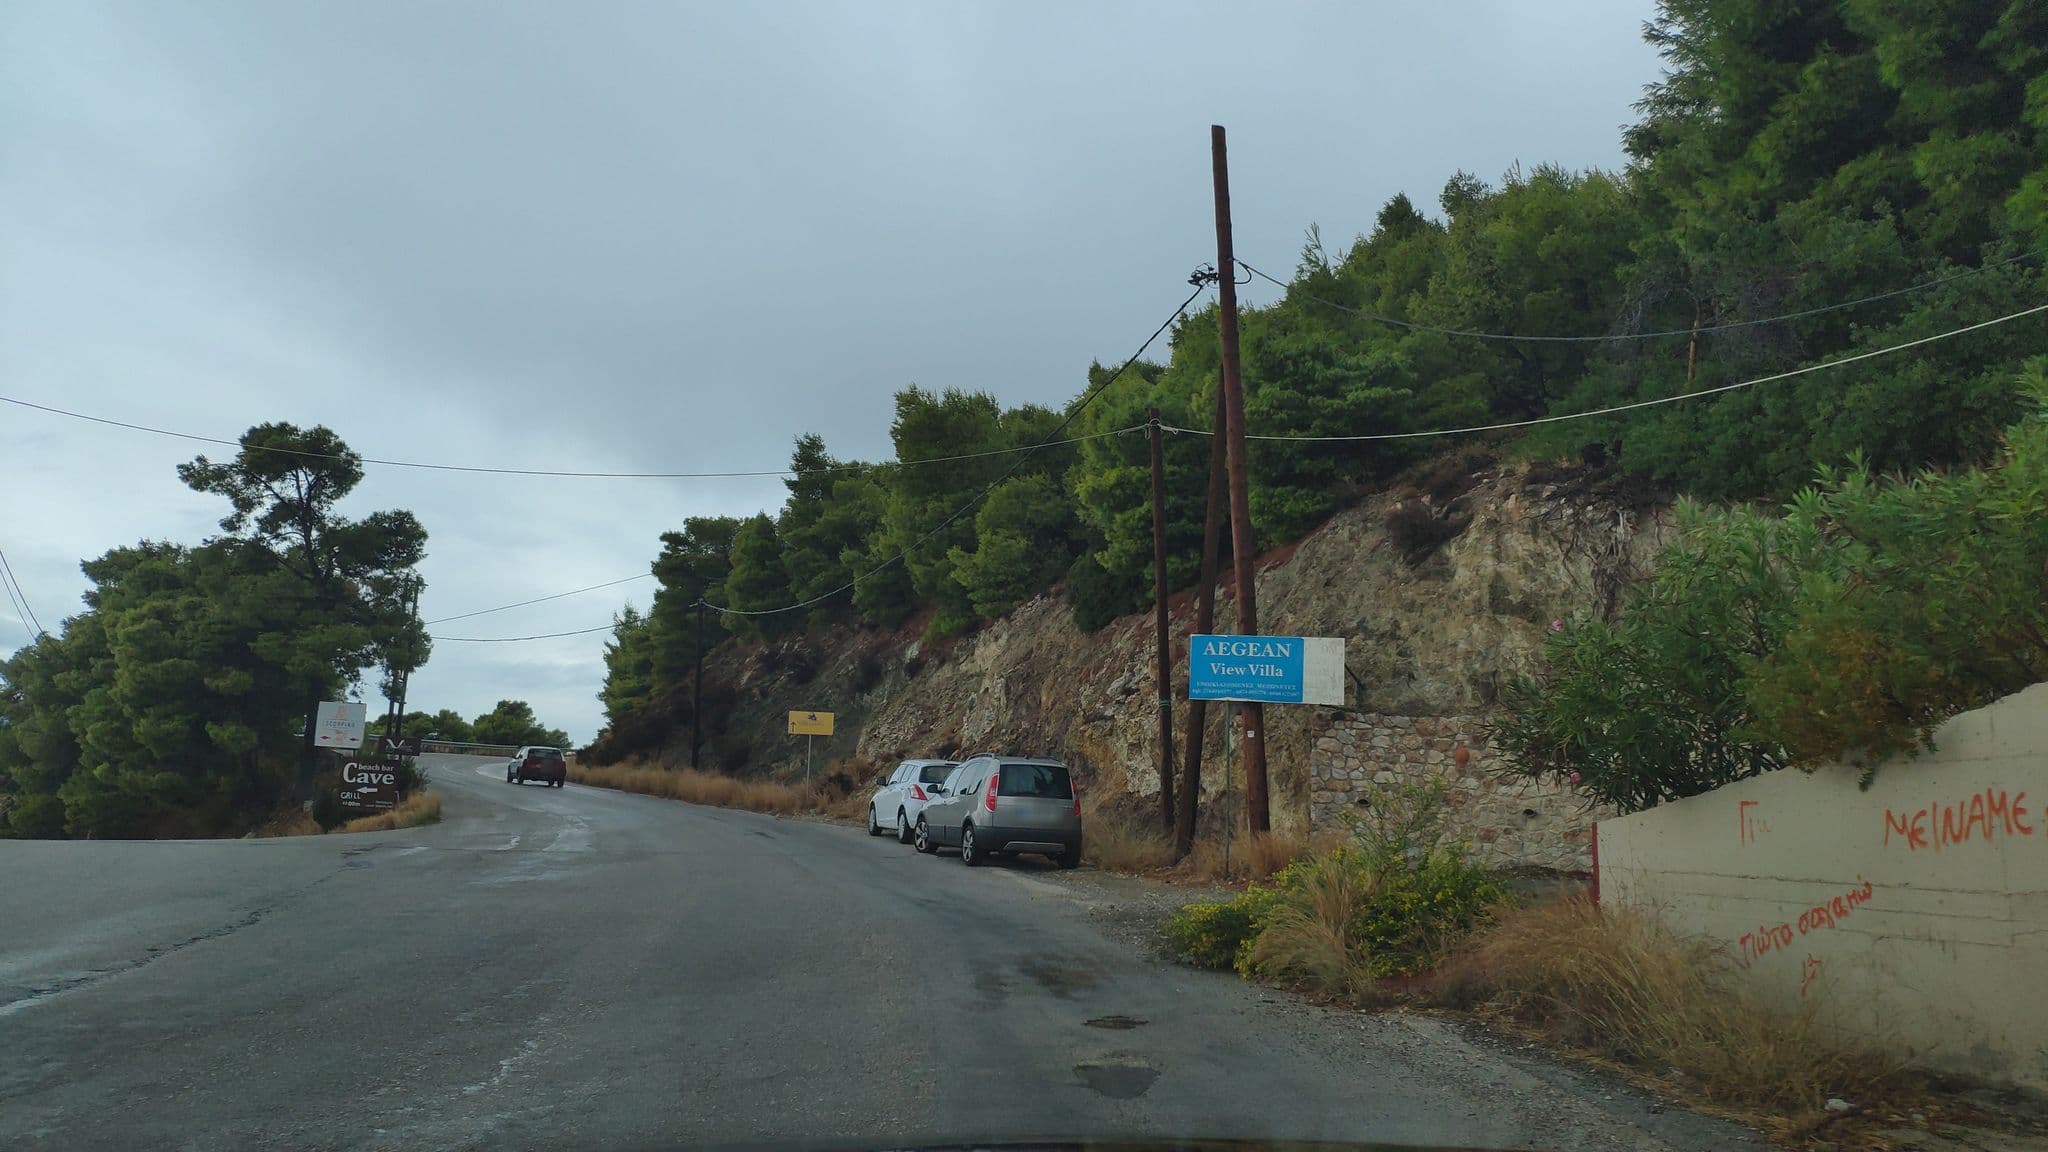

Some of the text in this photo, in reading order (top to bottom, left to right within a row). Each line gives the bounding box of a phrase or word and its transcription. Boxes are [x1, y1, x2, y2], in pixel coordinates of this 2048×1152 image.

[1203, 641, 1292, 657] AEGEAN
[1210, 662, 1284, 677] View Villa
[343, 762, 395, 785] Cave
[358, 763, 394, 772] beach bar
[340, 791, 361, 800] GRILL
